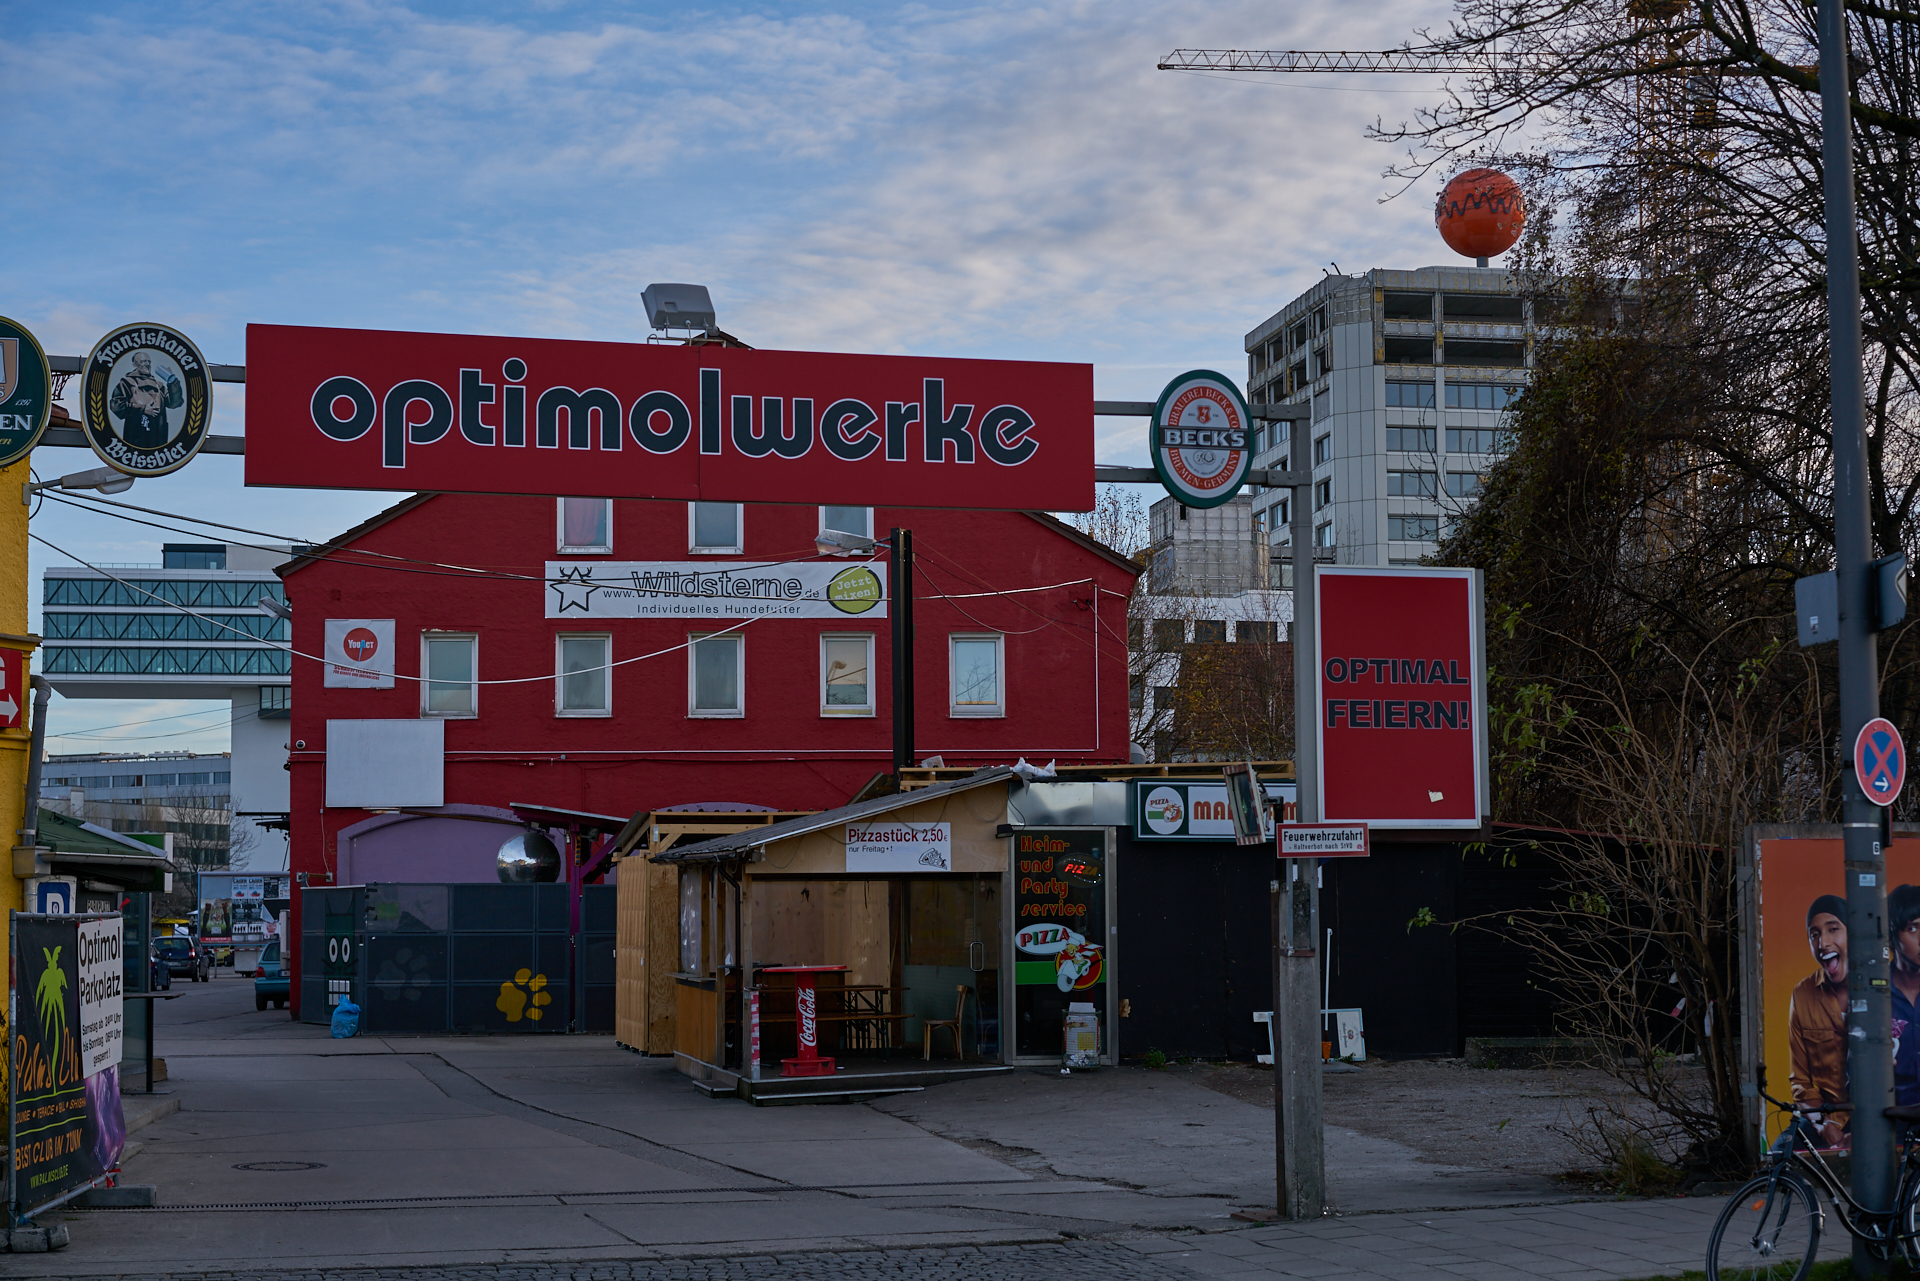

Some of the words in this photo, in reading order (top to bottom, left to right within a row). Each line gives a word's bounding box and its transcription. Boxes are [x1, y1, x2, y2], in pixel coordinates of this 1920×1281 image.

[97, 329, 198, 371] Franziskaner
[310, 356, 1040, 468] optimolwerke
[1169, 387, 1203, 426] BRAUEREI
[1205, 388, 1231, 409] BECK
[1164, 428, 1245, 447] BECK'S
[105, 437, 187, 469] Weissbier
[1170, 449, 1201, 487] BREMEN
[1203, 451, 1239, 489] GERMANY
[834, 586, 876, 602] mixen!
[836, 576, 872, 590] Jetzt
[637, 604, 719, 614] Individuelles
[725, 604, 801, 614] Hundefutter
[1325, 657, 1469, 685] OPTIMAL
[1326, 698, 1469, 729] FEIERN!
[1150, 798, 1169, 806] PIZZA
[848, 828, 919, 842] Pizzastück
[1020, 834, 1070, 852] Heim-
[1283, 830, 1363, 842] Feuerwehrzufahrt
[862, 845, 885, 853] Freitag
[1020, 856, 1054, 873] und
[1021, 877, 1069, 900] Party
[1021, 898, 1087, 917] service
[1020, 927, 1070, 947] PIZZA
[79, 927, 121, 973] Optimol
[80, 971, 121, 1007] Parkplatz
[82, 1022, 98, 1035] Samstag
[114, 1013, 122, 1023] Uhr
[798, 986, 817, 1047] Coca-Cola
[88, 1036, 104, 1049] Sonntag
[113, 1029, 122, 1039] Uhr
[15, 1034, 53, 1095] Palms
[15, 1143, 31, 1171] BEST
[33, 1138, 54, 1164] CLUB
